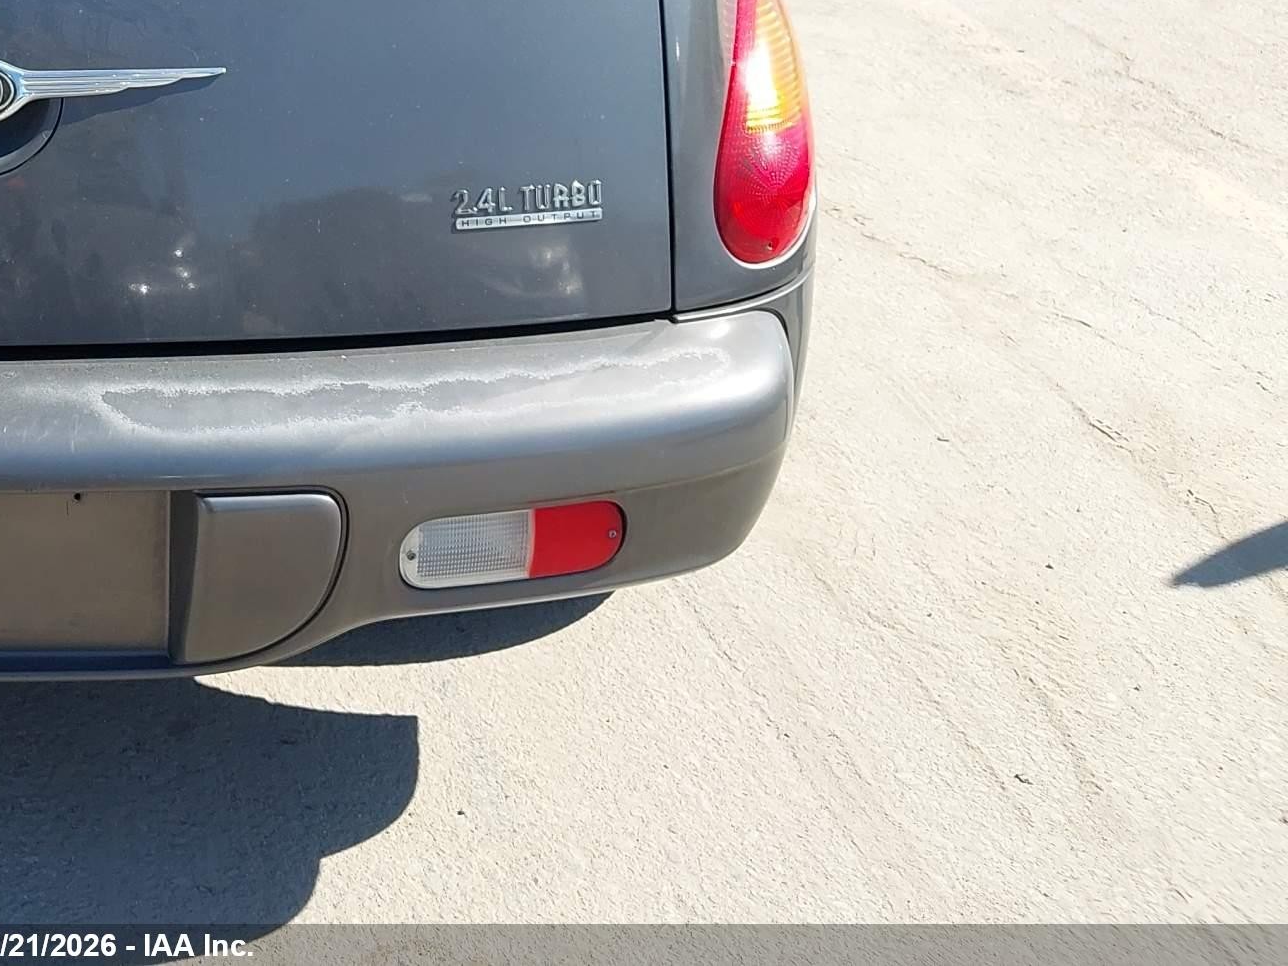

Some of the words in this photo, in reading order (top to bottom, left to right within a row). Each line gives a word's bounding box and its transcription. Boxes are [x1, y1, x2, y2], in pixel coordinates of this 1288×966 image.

[451, 187, 514, 215] 2.4L
[520, 179, 602, 212] TURBO
[461, 217, 508, 228] HIGH
[522, 210, 598, 224] OUTPUT
